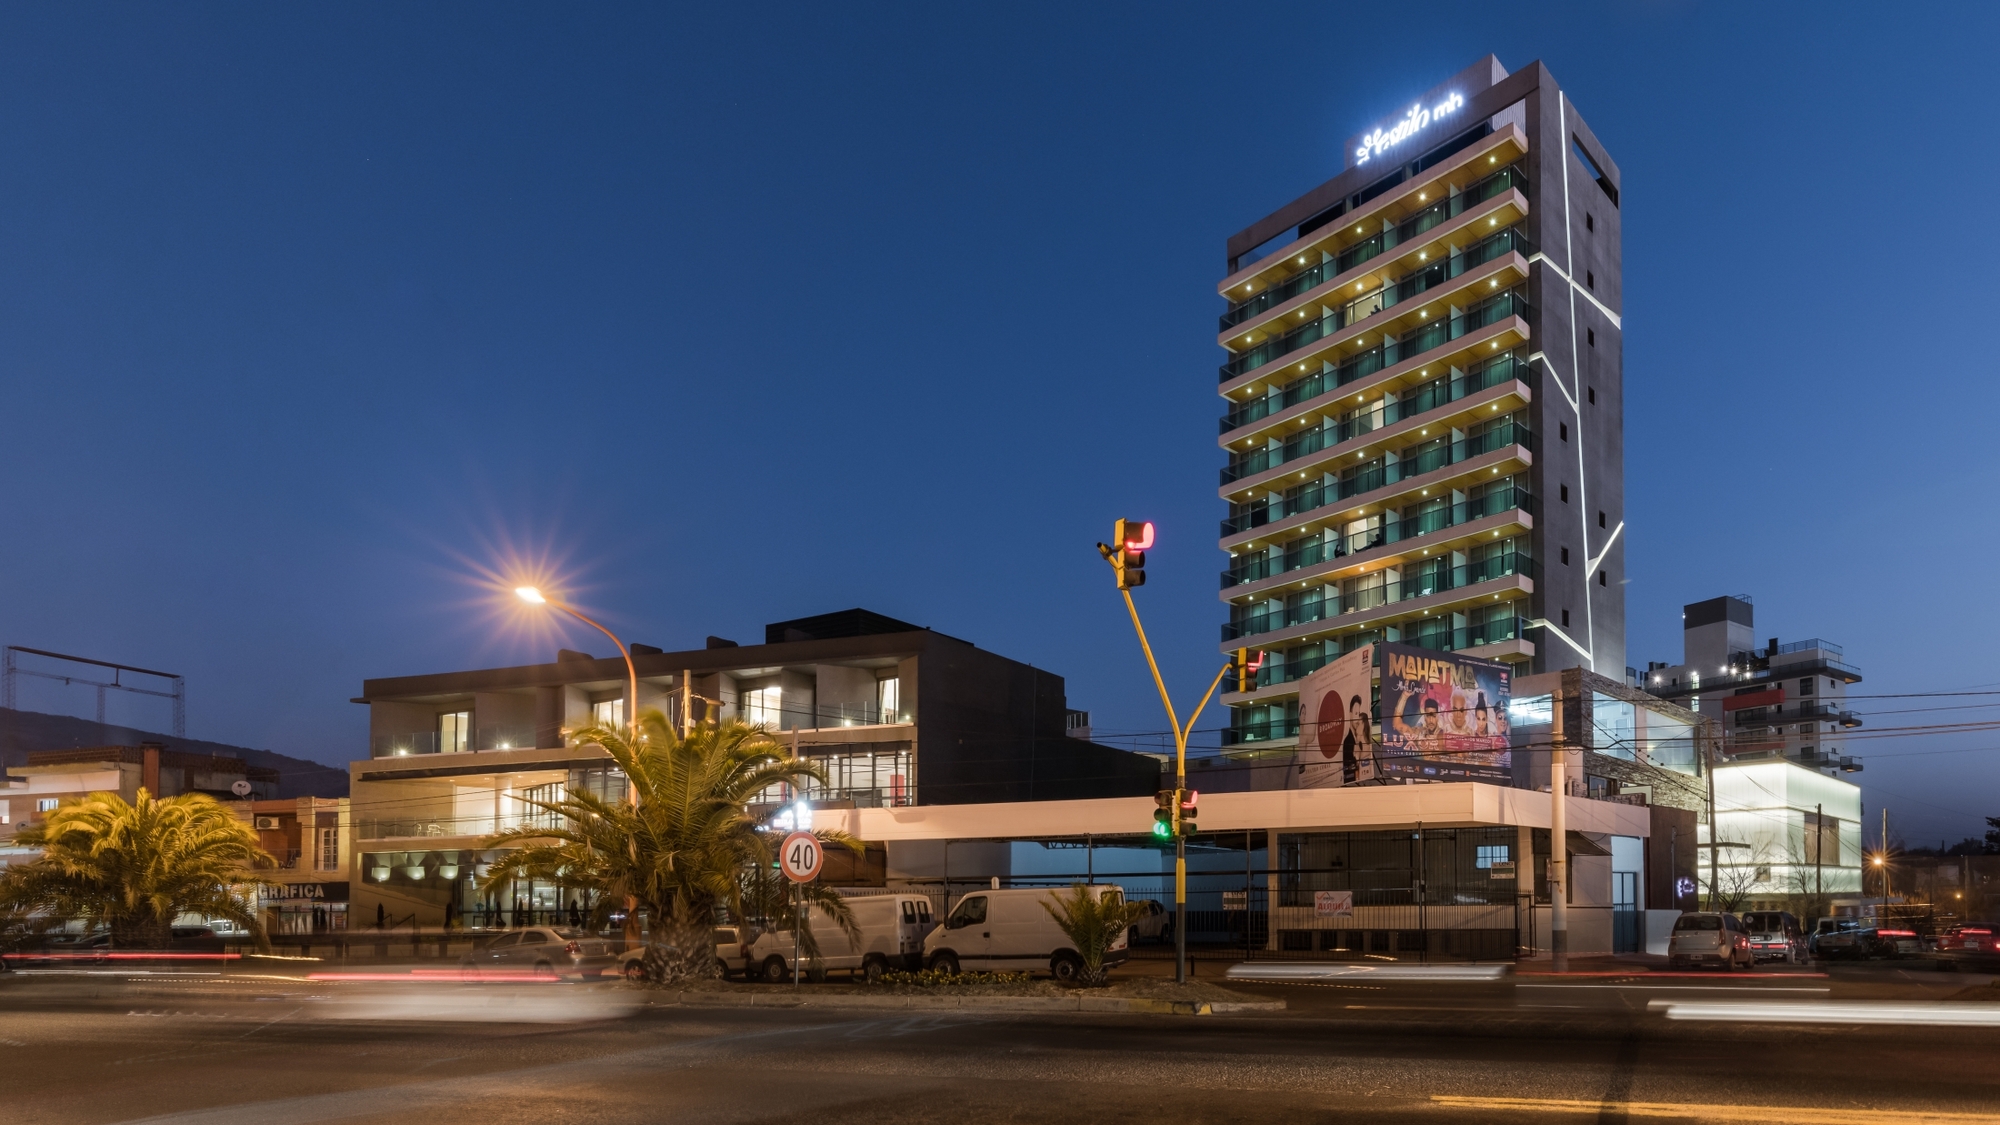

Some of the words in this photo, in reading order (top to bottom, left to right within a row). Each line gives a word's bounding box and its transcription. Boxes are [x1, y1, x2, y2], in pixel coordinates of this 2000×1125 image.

[1388, 652, 1476, 690] MAHATMA
[1383, 733, 1440, 751] LUXOR
[790, 844, 814, 870] 40
